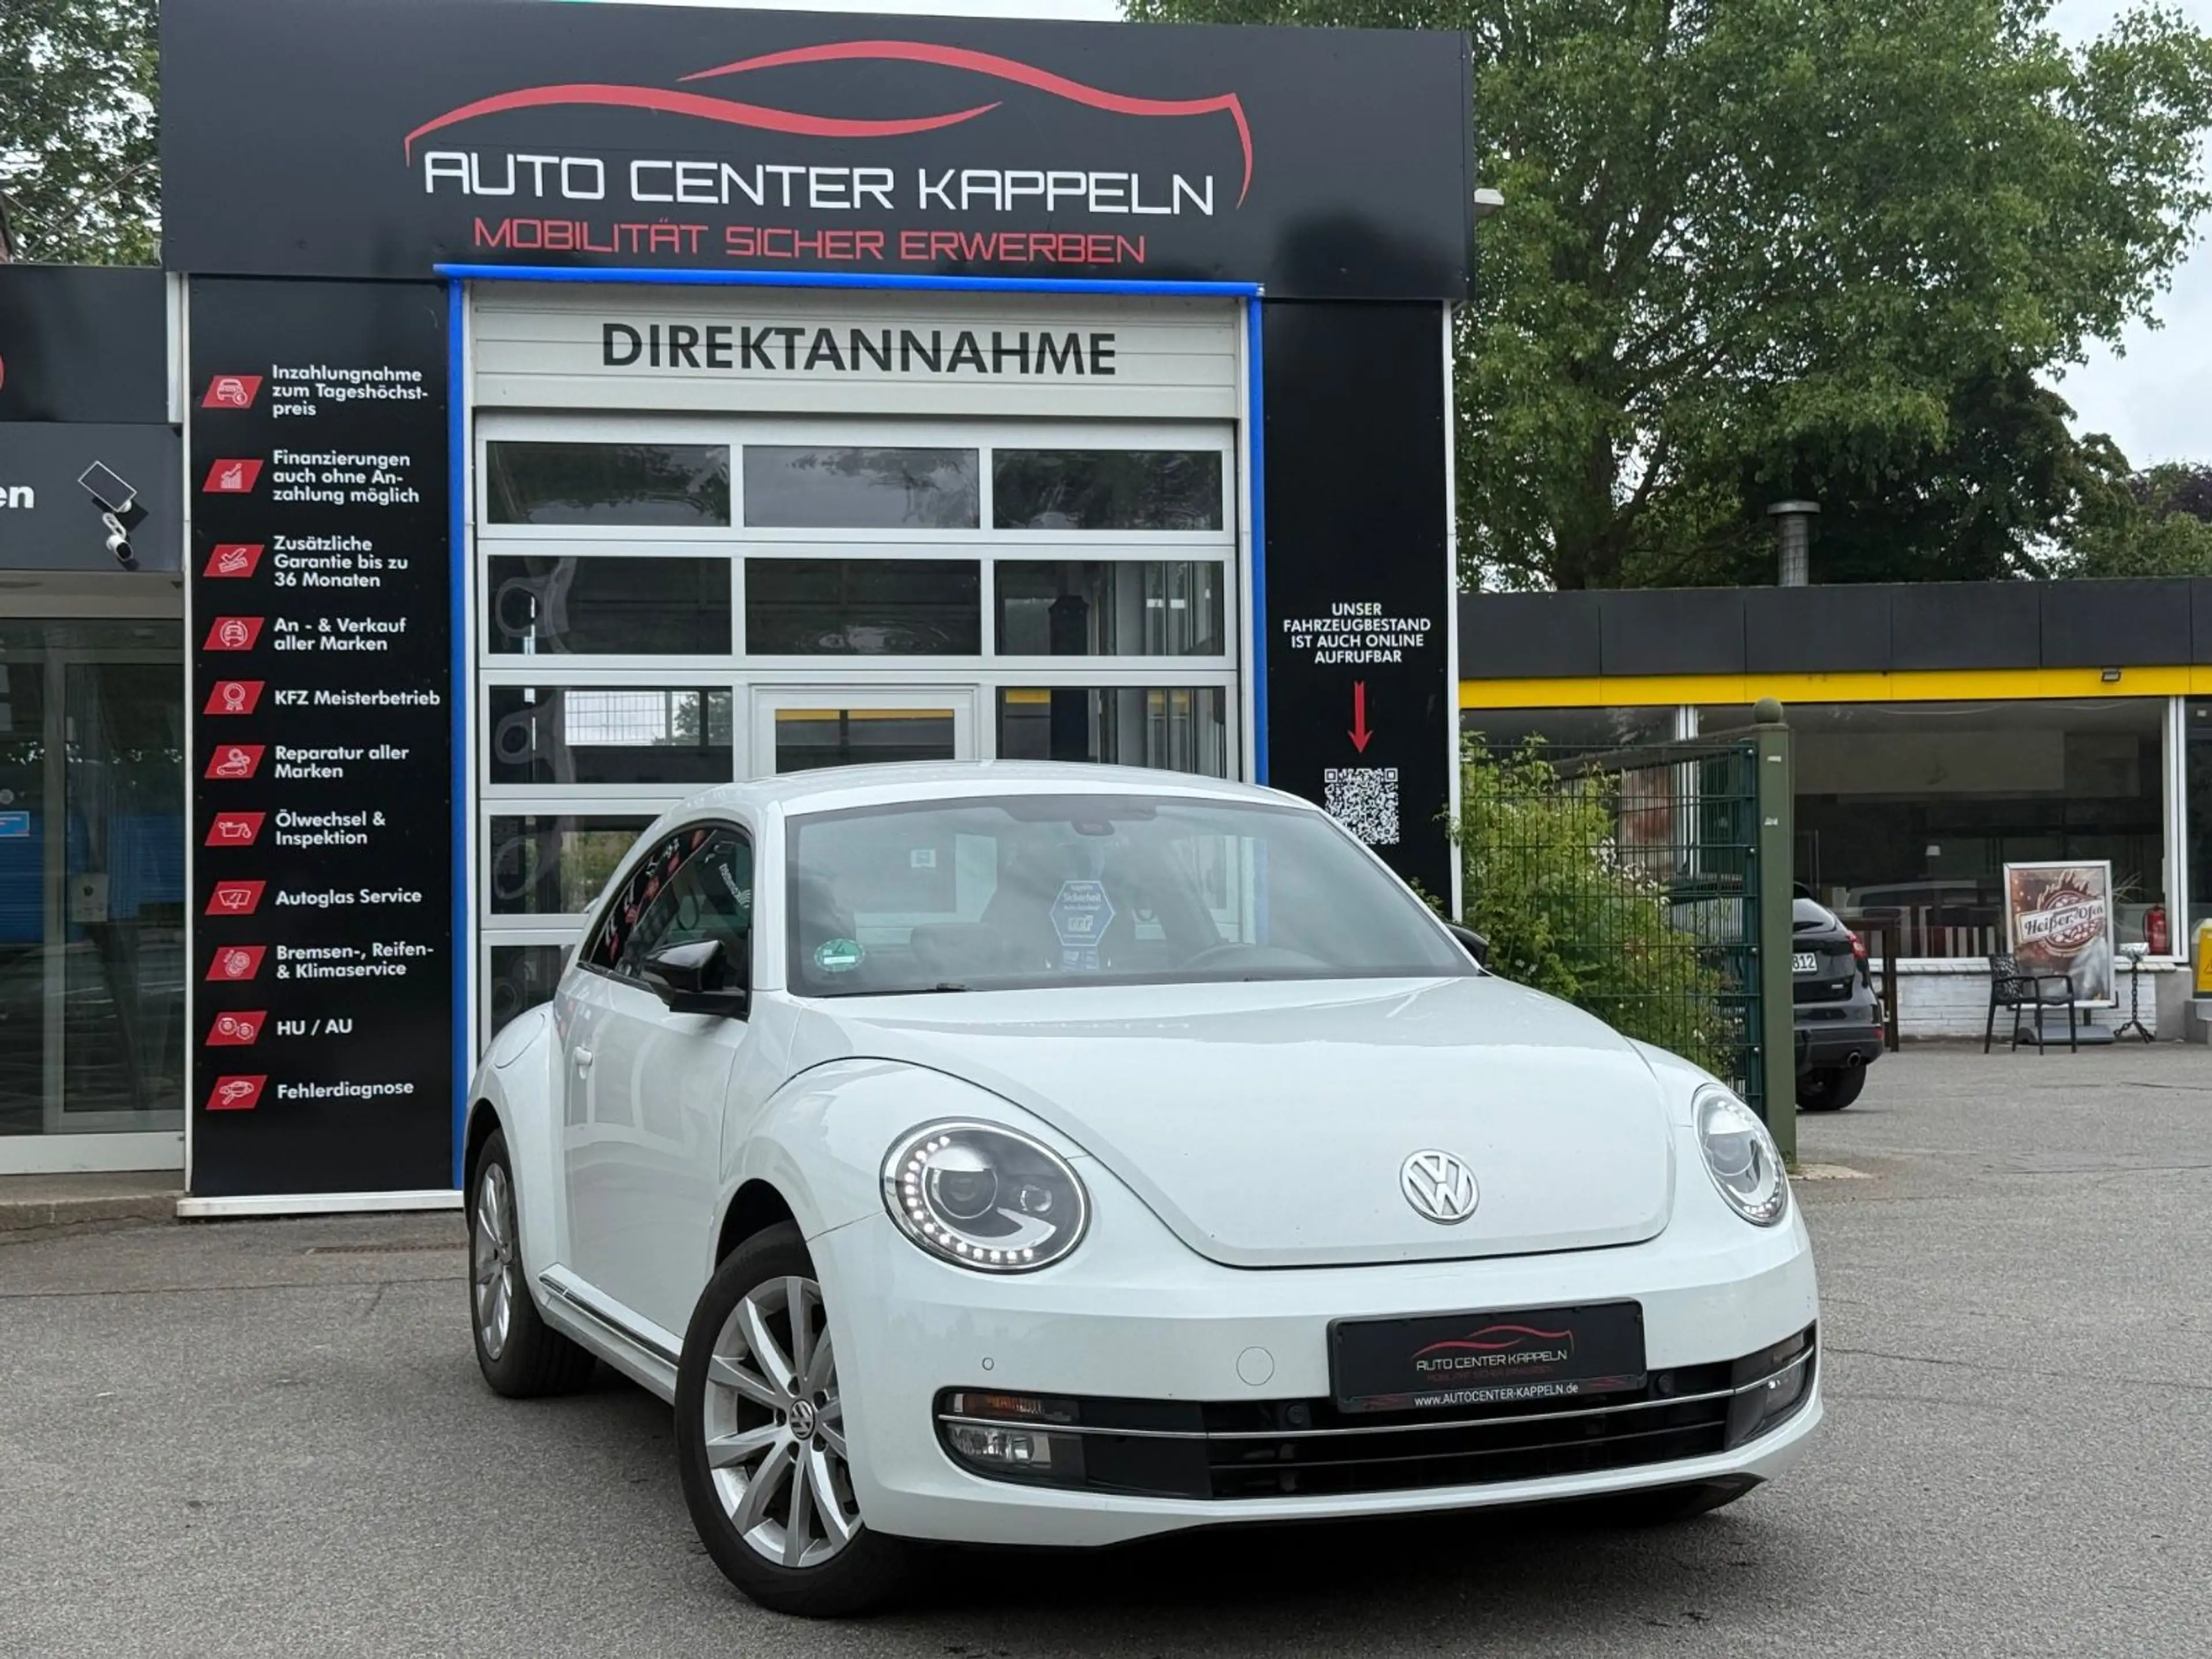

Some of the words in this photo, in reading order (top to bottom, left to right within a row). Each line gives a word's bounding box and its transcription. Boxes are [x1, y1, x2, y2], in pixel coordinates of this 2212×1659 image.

[425, 151, 605, 200] AUTO
[630, 160, 894, 209] CENTER
[919, 168, 1213, 215] KAPPELN
[474, 217, 709, 254] MOBILITÄT
[725, 226, 885, 260] SICHER
[900, 230, 1146, 264] ERWERBEN
[603, 323, 1116, 376] DIREKTANNAHME
[272, 365, 422, 384] Inzahlungnahme
[272, 386, 309, 397] zum
[315, 382, 428, 402] Tageshöchst-
[272, 401, 316, 418] preis
[274, 449, 410, 470] Finanzierungen
[273, 467, 316, 483] auch
[321, 468, 366, 483] ohne
[371, 469, 403, 484] An-
[273, 486, 344, 505] zahlung
[350, 487, 419, 506] möglich
[274, 535, 372, 551] Zusätzliche
[274, 553, 353, 569] Garantie
[358, 554, 382, 569] bis
[388, 559, 408, 569] zu
[274, 571, 297, 586] 36
[302, 572, 380, 587] Monaten
[1332, 603, 1382, 616] UNSER
[318, 618, 331, 632] &
[336, 617, 406, 632] Verkauf
[1283, 618, 1431, 632] FAHRZEUGBESTAND
[274, 635, 316, 650] aller
[320, 635, 388, 651] Marken
[1291, 635, 1313, 648] IST
[1317, 634, 1361, 648] AUCH
[1366, 634, 1423, 647] ONLINE
[1315, 650, 1402, 664] AUFRUFBAR
[275, 690, 309, 705] KFZ
[314, 690, 440, 705] Meisterbetrieb
[276, 745, 364, 764] Reparatur
[369, 744, 410, 760] aller
[275, 763, 343, 778] Marken
[275, 809, 366, 827] Ölwechsel
[373, 811, 385, 826] &
[276, 829, 368, 849] Inspektion
[275, 889, 355, 908] Autoglas
[360, 887, 422, 903] Service
[277, 945, 366, 960] Bremsen-,
[373, 941, 434, 957] Reifen-
[276, 964, 290, 979] &
[296, 960, 407, 978] Klimaservice
[277, 1020, 305, 1035] HU
[325, 1018, 352, 1034] AU
[278, 1081, 414, 1099] Fehlerdiagnose
[1416, 1358, 1453, 1372] AUTO
[1454, 1354, 1507, 1369] CENTER
[1508, 1349, 1568, 1365] KAPPELN
[1414, 1382, 1579, 1407] www.AUTOCENTER-KAPPELN.de
